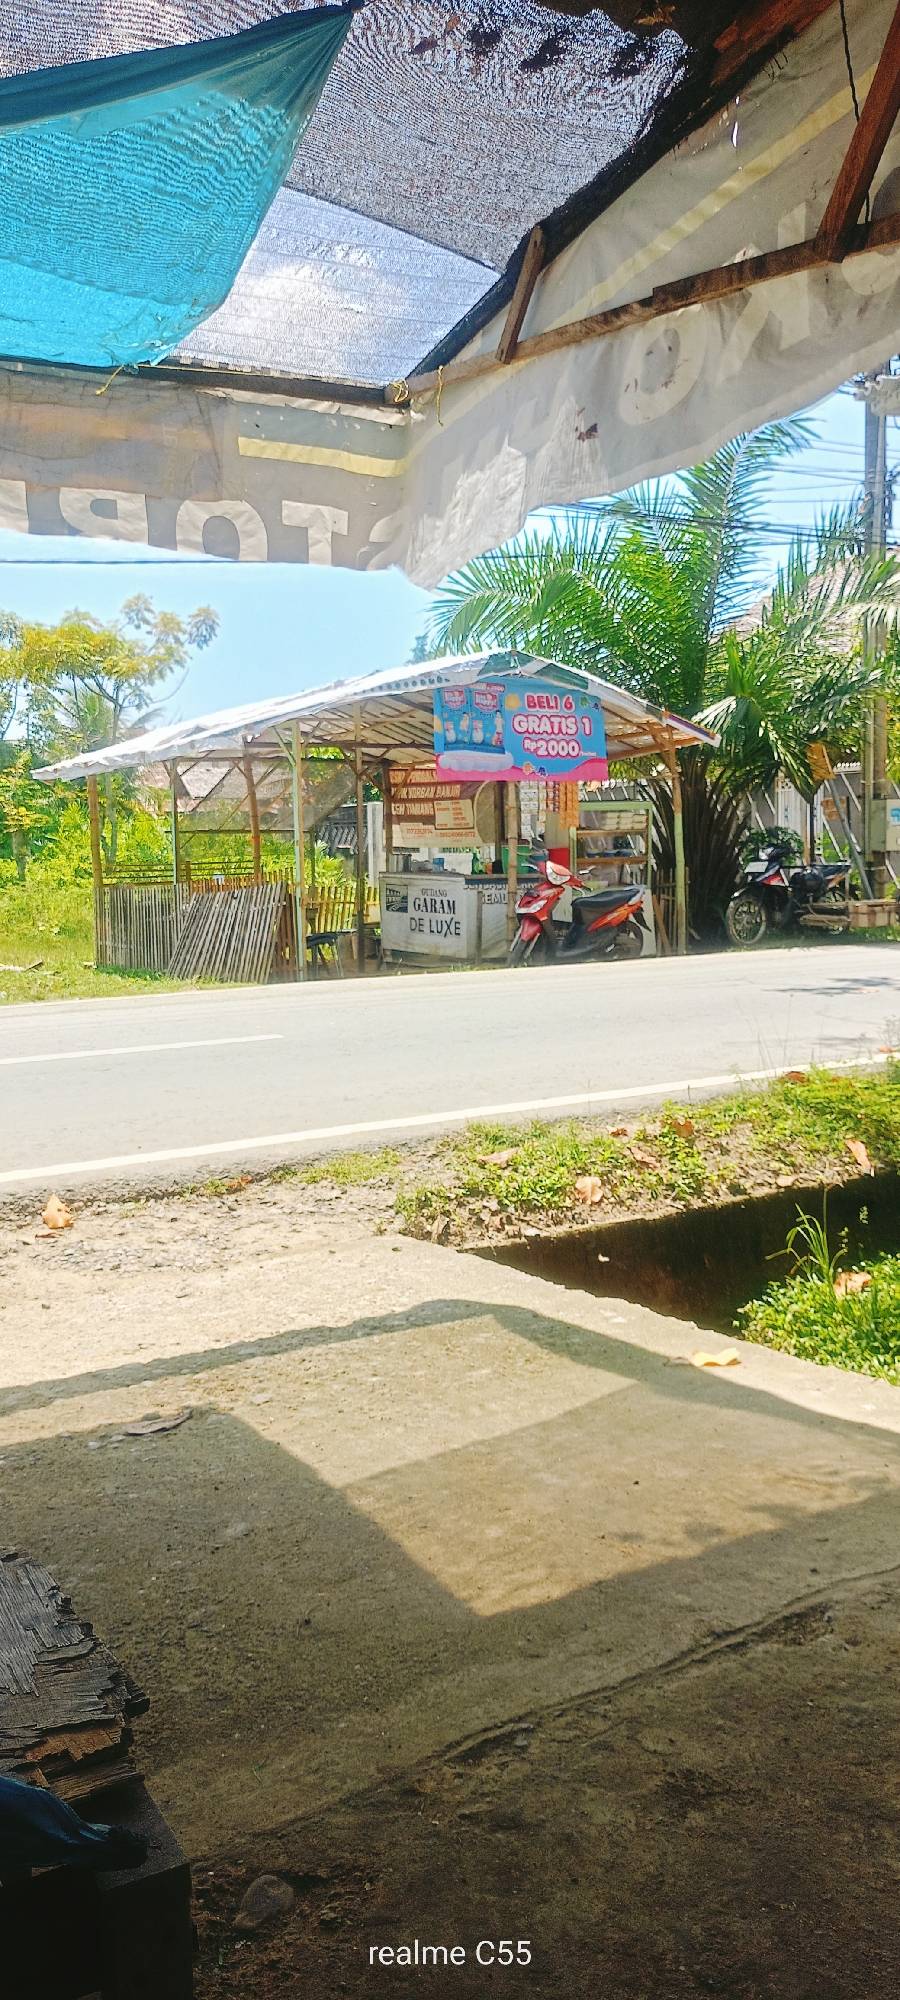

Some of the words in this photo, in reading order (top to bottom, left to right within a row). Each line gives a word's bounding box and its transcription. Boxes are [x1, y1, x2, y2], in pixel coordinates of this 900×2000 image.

[525, 693, 560, 711] BELI
[563, 695, 574, 712] 6
[513, 714, 578, 735] GRATIS
[581, 716, 592, 736] 1
[522, 737, 581, 757] Rp2000
[391, 803, 404, 815] CEH
[421, 887, 447, 898] GUDANG
[413, 896, 456, 915] GARAM
[409, 917, 424, 933] DE
[429, 917, 461, 938] LUXE
